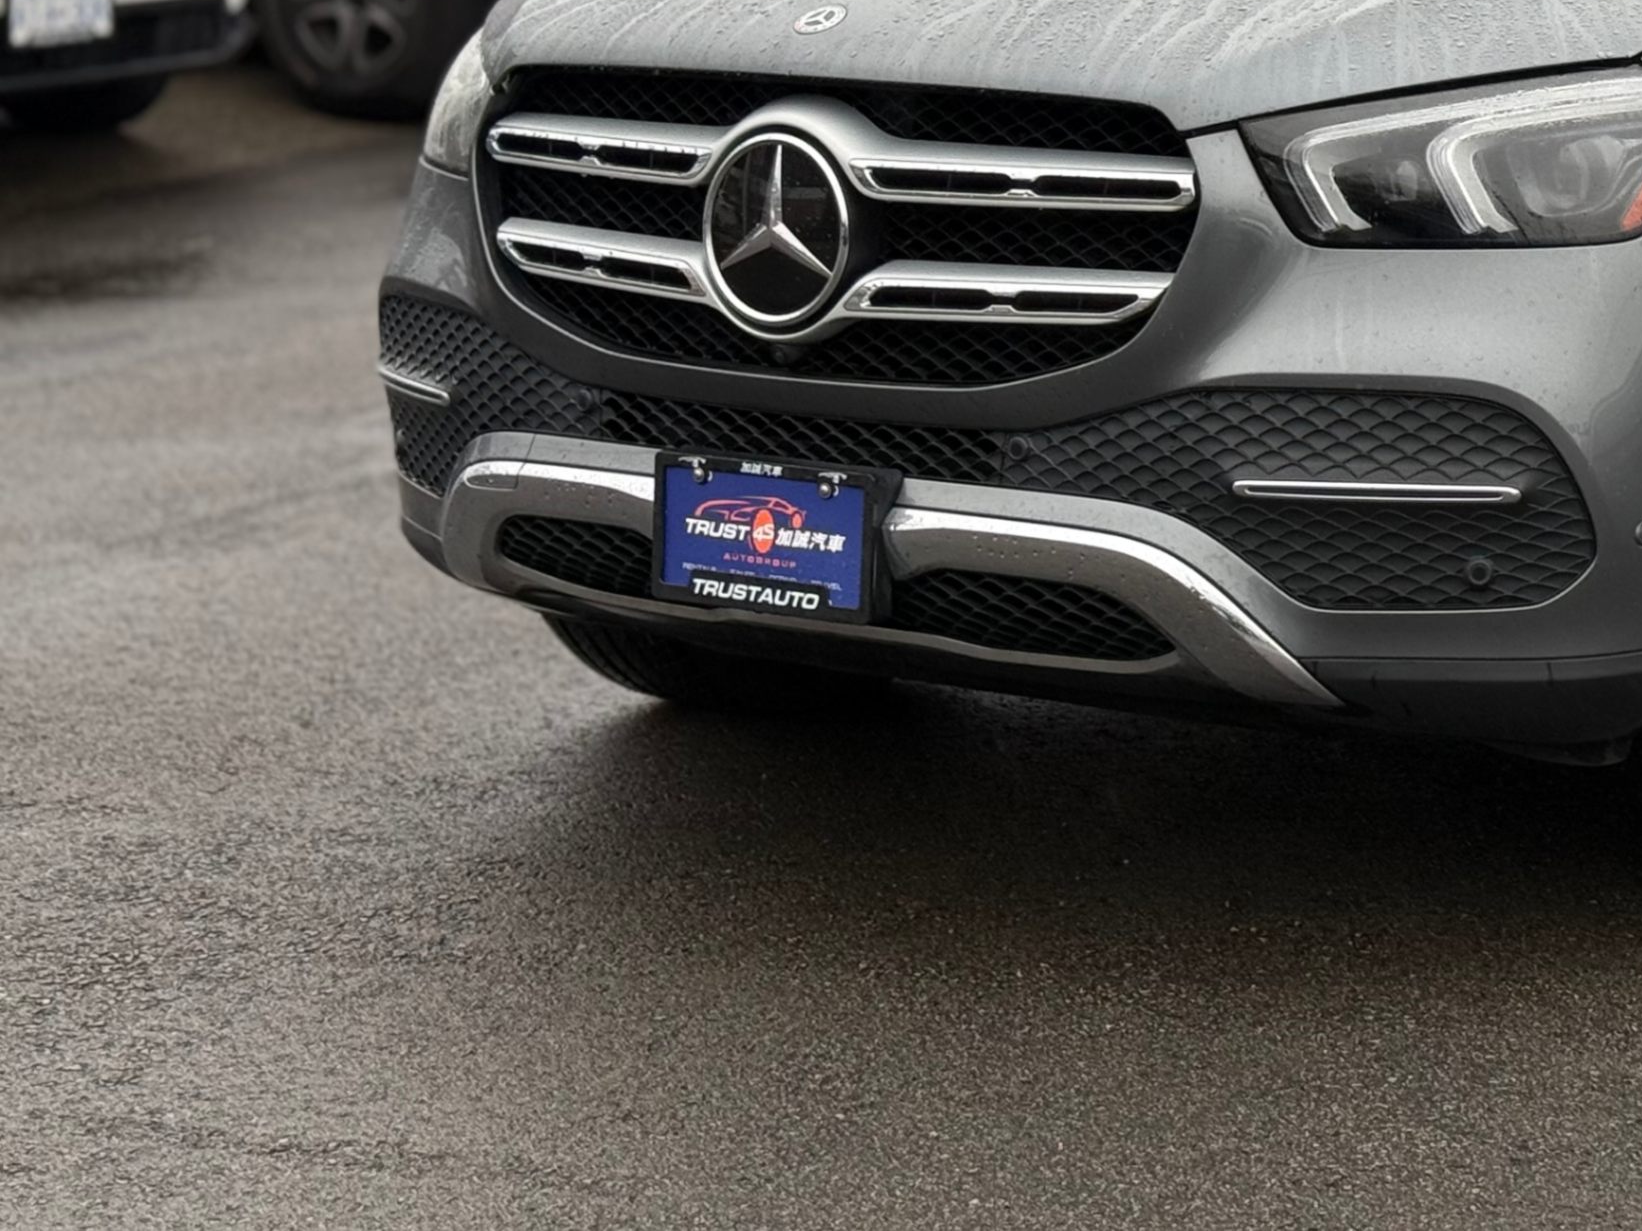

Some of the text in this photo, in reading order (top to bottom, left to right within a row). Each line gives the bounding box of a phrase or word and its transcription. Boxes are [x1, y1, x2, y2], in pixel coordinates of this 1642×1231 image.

[685, 518, 750, 541] TRUST
[775, 528, 847, 553] 加誠汽車
[692, 578, 820, 610] TRUSTAUTO
